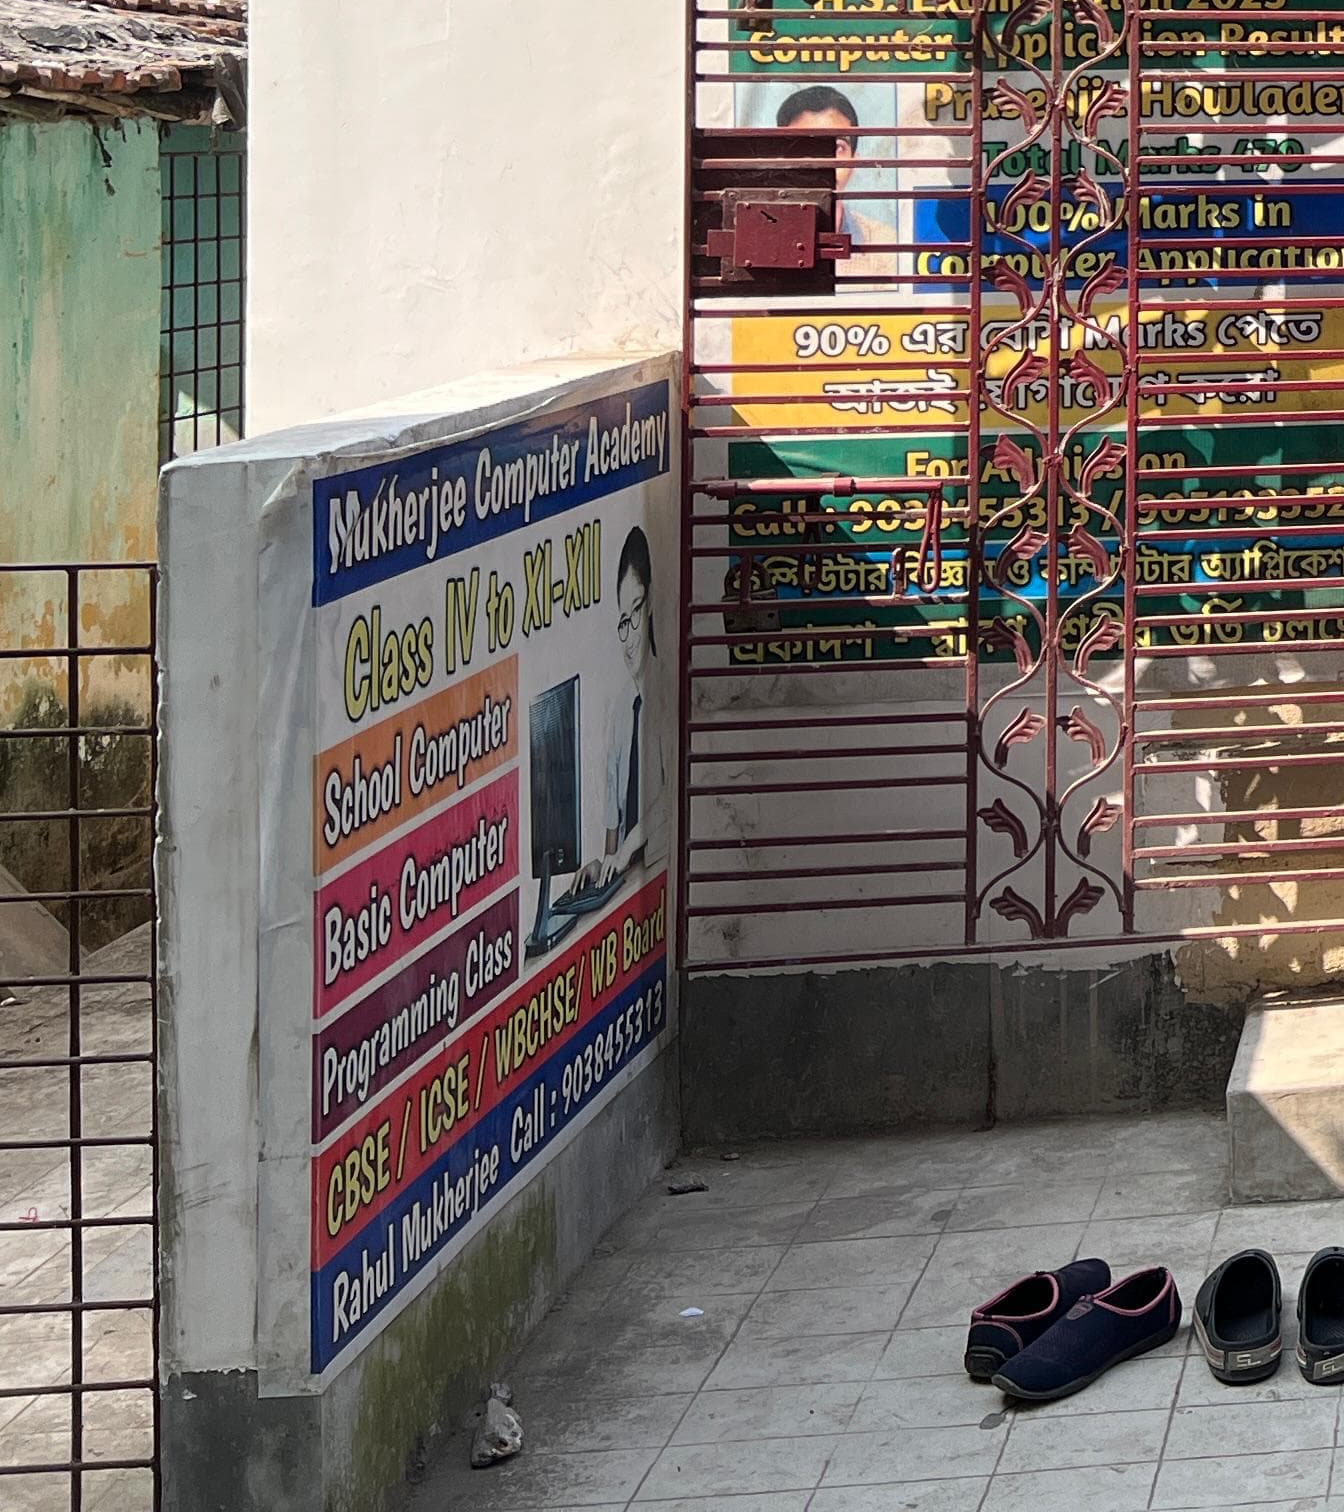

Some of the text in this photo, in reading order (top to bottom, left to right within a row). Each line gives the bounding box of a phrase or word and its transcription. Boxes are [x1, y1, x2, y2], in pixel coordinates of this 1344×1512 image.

[750, 29, 954, 73] Computer
[1231, 138, 1305, 173] 470
[1253, 192, 1291, 229] in
[794, 324, 890, 358] 90%
[329, 402, 667, 573] Mukherjee Computer Academy
[343, 519, 601, 723] Class IV to XI-XII
[323, 696, 511, 848] School Computer
[324, 815, 508, 986] Basic Computer
[322, 929, 513, 1118] Programming Class
[325, 1117, 392, 1239] CBSE
[420, 1055, 469, 1154] ICSE
[590, 936, 617, 998] WB
[622, 900, 665, 971] Board
[332, 1224, 396, 1343] Rahul
[402, 1143, 499, 1273] Mukherjee
[510, 1083, 545, 1164] Call
[562, 982, 662, 1114] 9038455313
